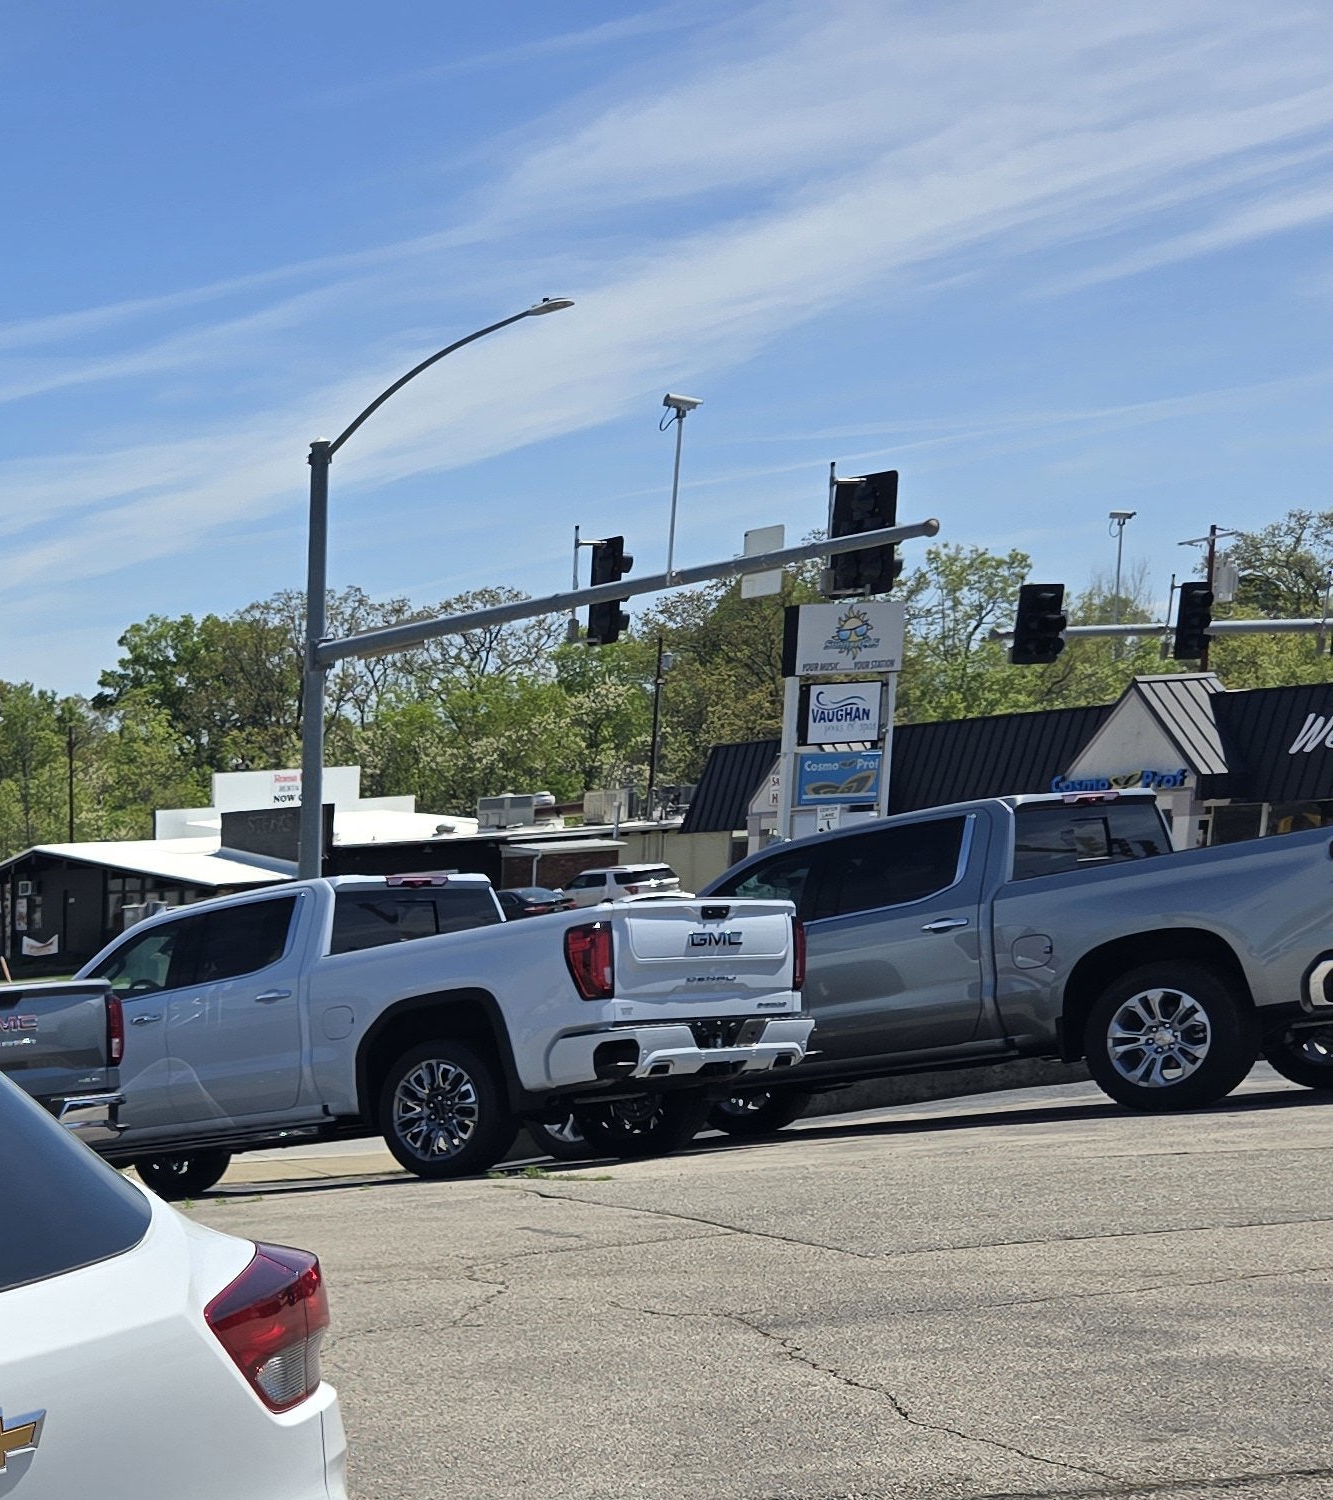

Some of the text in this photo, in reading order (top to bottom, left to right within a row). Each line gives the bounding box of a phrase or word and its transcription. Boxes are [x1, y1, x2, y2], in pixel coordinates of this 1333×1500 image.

[811, 707, 870, 724] VAUGHAN
[804, 758, 880, 772] Cosmo Prof
[1050, 769, 1188, 793] Cosmo Prof
[273, 794, 297, 803] NOW
[688, 930, 744, 947] GMC
